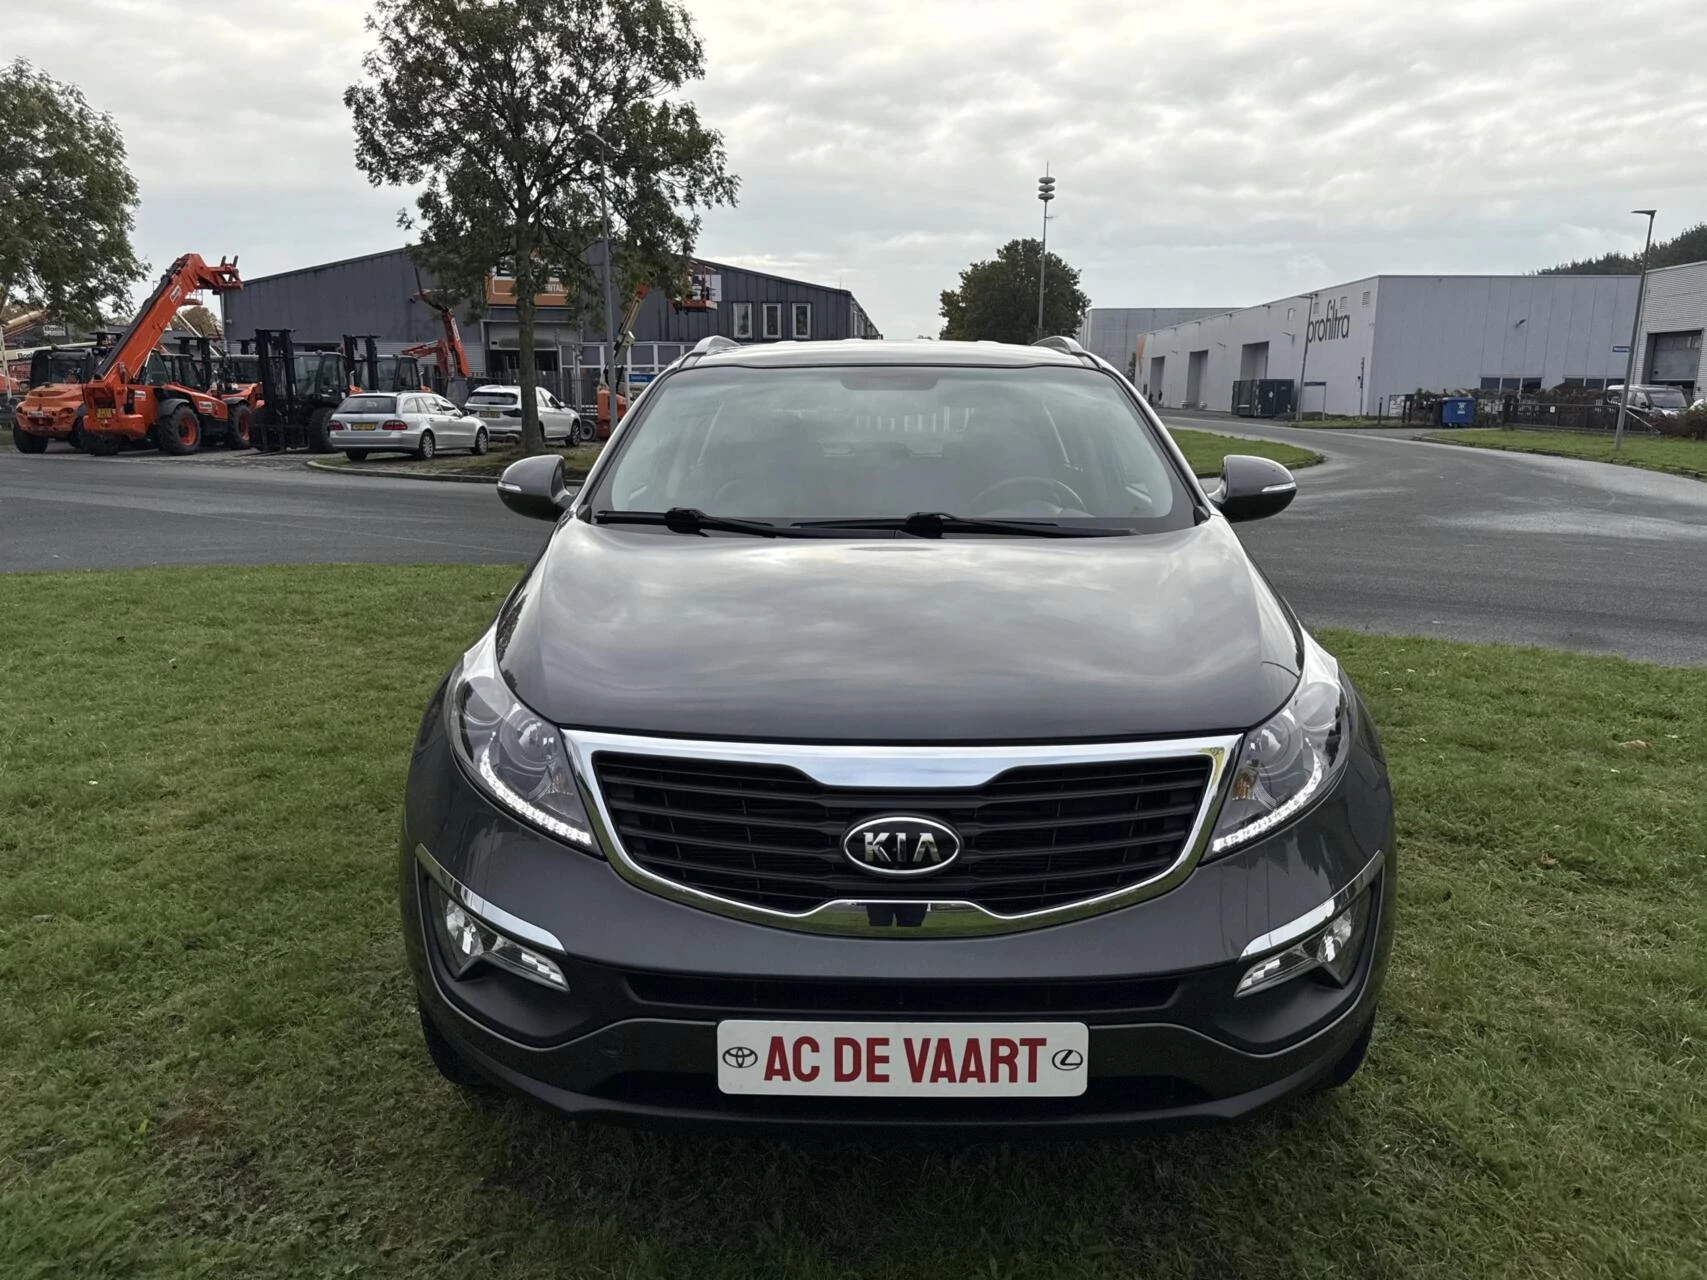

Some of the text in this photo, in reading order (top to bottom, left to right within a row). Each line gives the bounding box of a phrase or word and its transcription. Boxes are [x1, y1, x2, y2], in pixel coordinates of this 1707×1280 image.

[862, 832, 942, 862] KIA
[763, 1035, 1047, 1083] AC DE VAART
